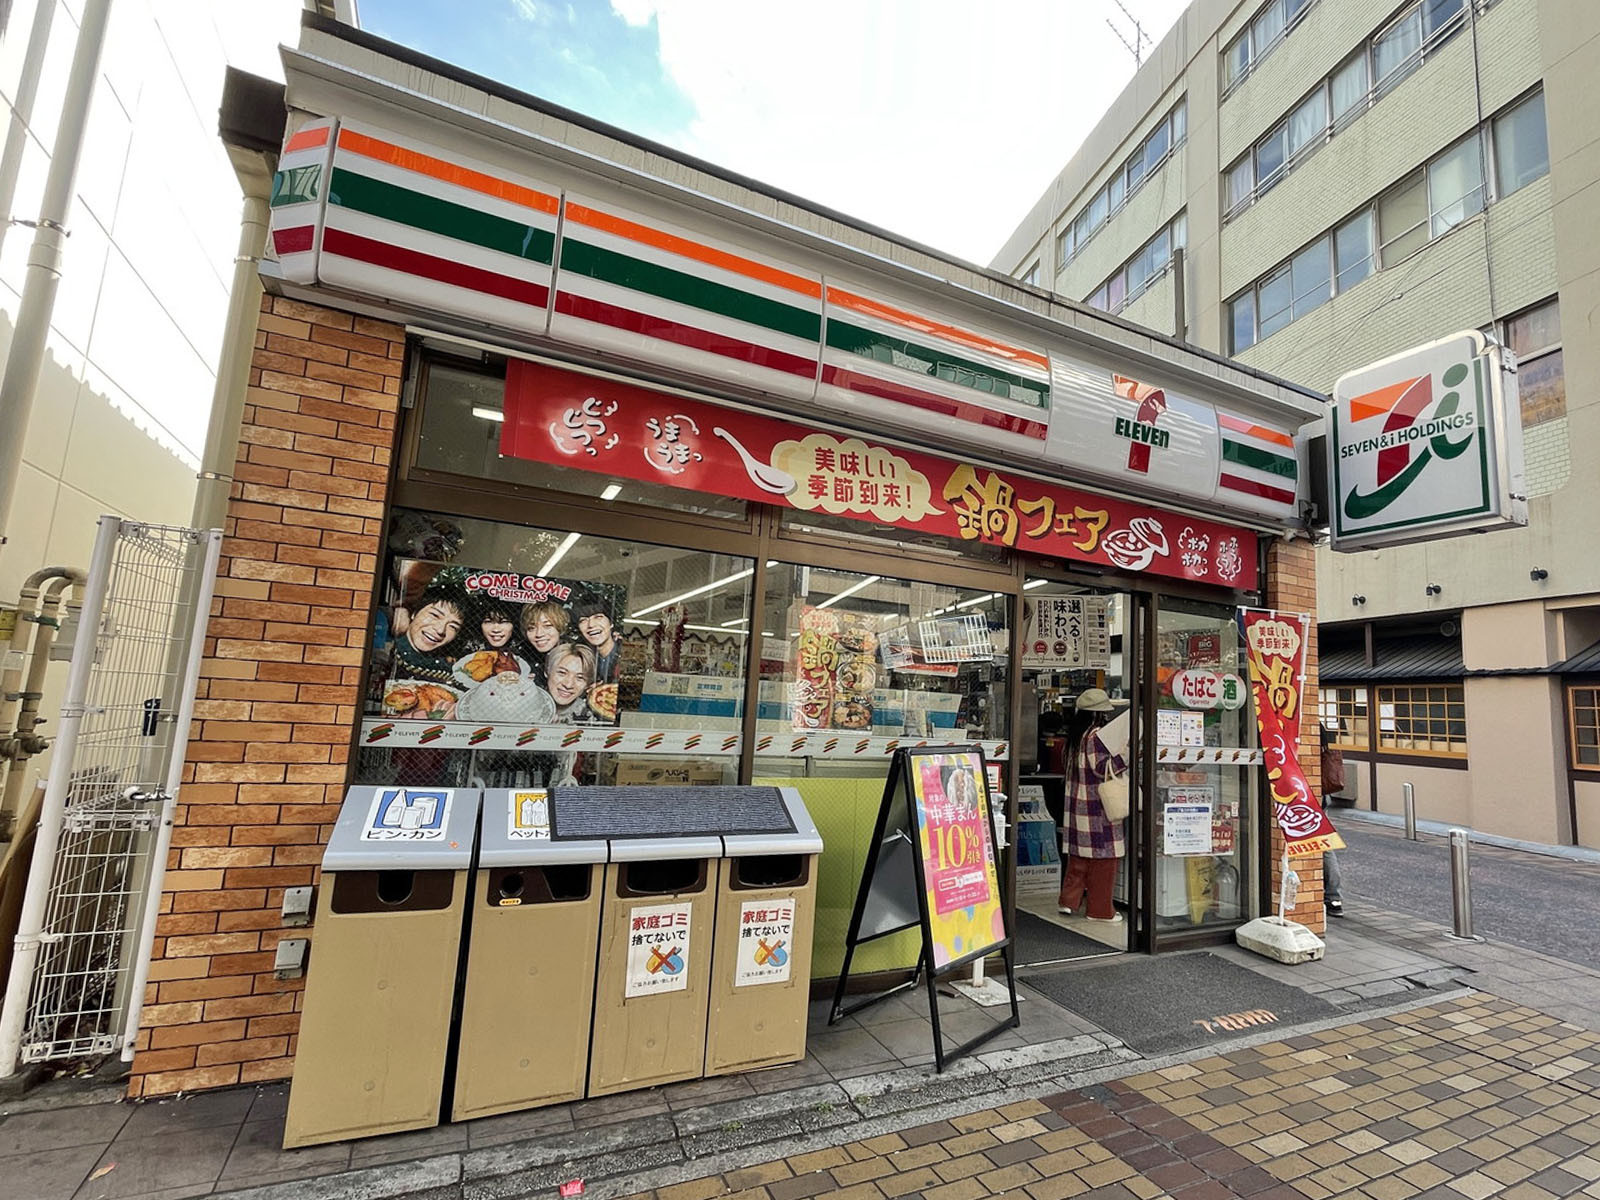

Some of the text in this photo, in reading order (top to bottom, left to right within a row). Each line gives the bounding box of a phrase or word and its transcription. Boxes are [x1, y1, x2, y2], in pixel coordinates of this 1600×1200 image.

[1398, 411, 1474, 442] HOLDINGS
[815, 447, 895, 479] 美味しい
[943, 464, 1109, 551] 鍋フェア
[466, 574, 571, 600] COME COME
[488, 587, 547, 602] CHRISTMAS
[1259, 626, 1289, 637] 美味しい
[1182, 675, 1216, 698] たばこ
[1223, 679, 1237, 700] 酒
[930, 803, 976, 825] 中華まん
[367, 830, 441, 839] ビン・カン
[933, 824, 979, 871] 10%
[632, 913, 687, 930] 家庭ゴミ
[743, 908, 791, 924] 家庭ゴミ
[632, 930, 686, 946] 捨てないで
[742, 925, 790, 938] 捨てないで
